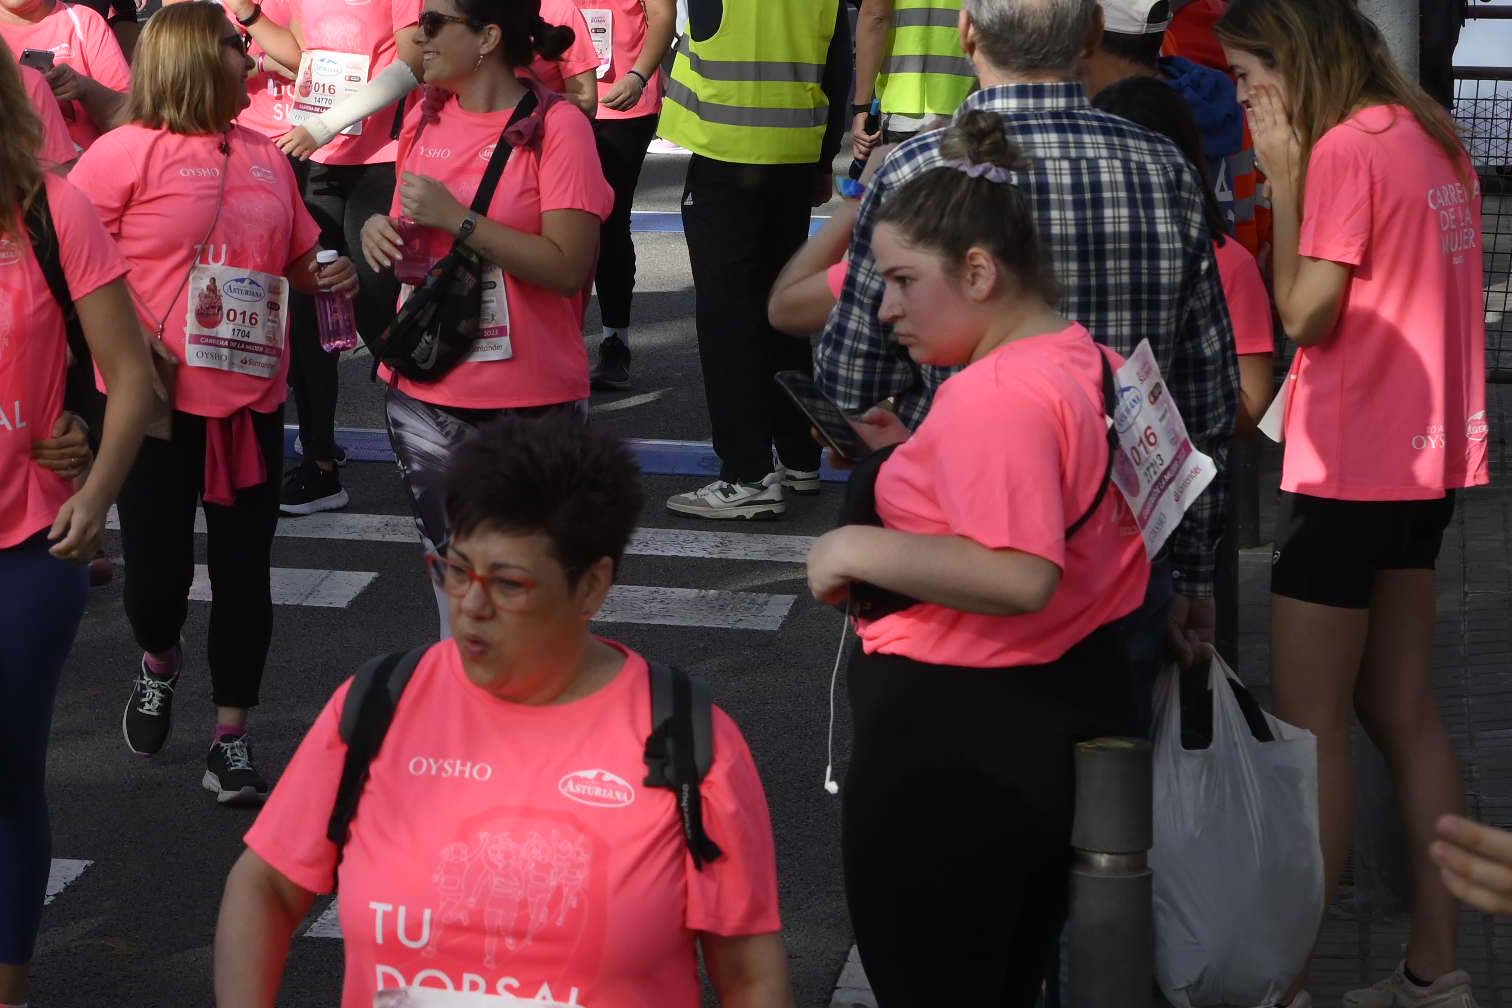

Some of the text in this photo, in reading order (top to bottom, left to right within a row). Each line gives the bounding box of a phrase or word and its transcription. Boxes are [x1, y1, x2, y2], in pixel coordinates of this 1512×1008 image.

[313, 82, 336, 95] 016
[1440, 209, 1456, 231] DE
[193, 243, 227, 266] TU
[226, 307, 259, 327] 016
[232, 328, 251, 339] 1704
[196, 350, 228, 363] OYSHO
[1129, 424, 1158, 467] 016
[408, 756, 493, 781] OYSHO
[565, 778, 628, 802] ASTURIANA
[368, 900, 432, 949] TU
